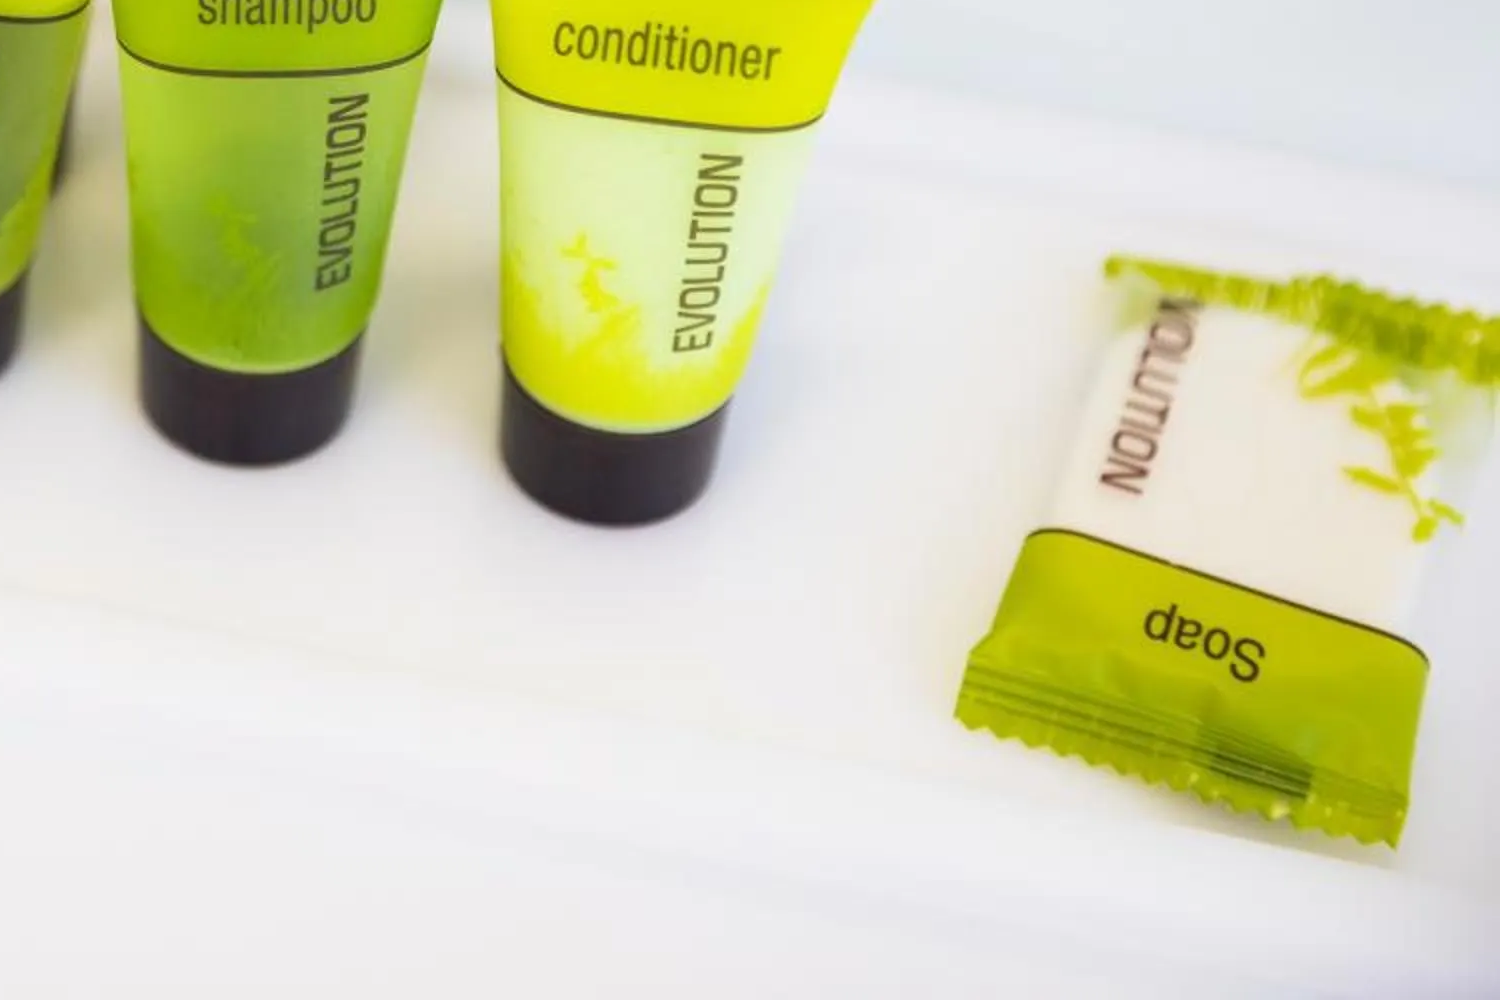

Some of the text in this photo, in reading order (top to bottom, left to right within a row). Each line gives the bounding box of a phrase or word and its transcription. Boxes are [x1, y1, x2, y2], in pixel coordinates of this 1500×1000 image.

[553, 20, 783, 81] conditioner
[313, 92, 371, 292] EVOLUTION
[671, 153, 744, 353] EVOLUTION
[1143, 603, 1266, 683] Soap
